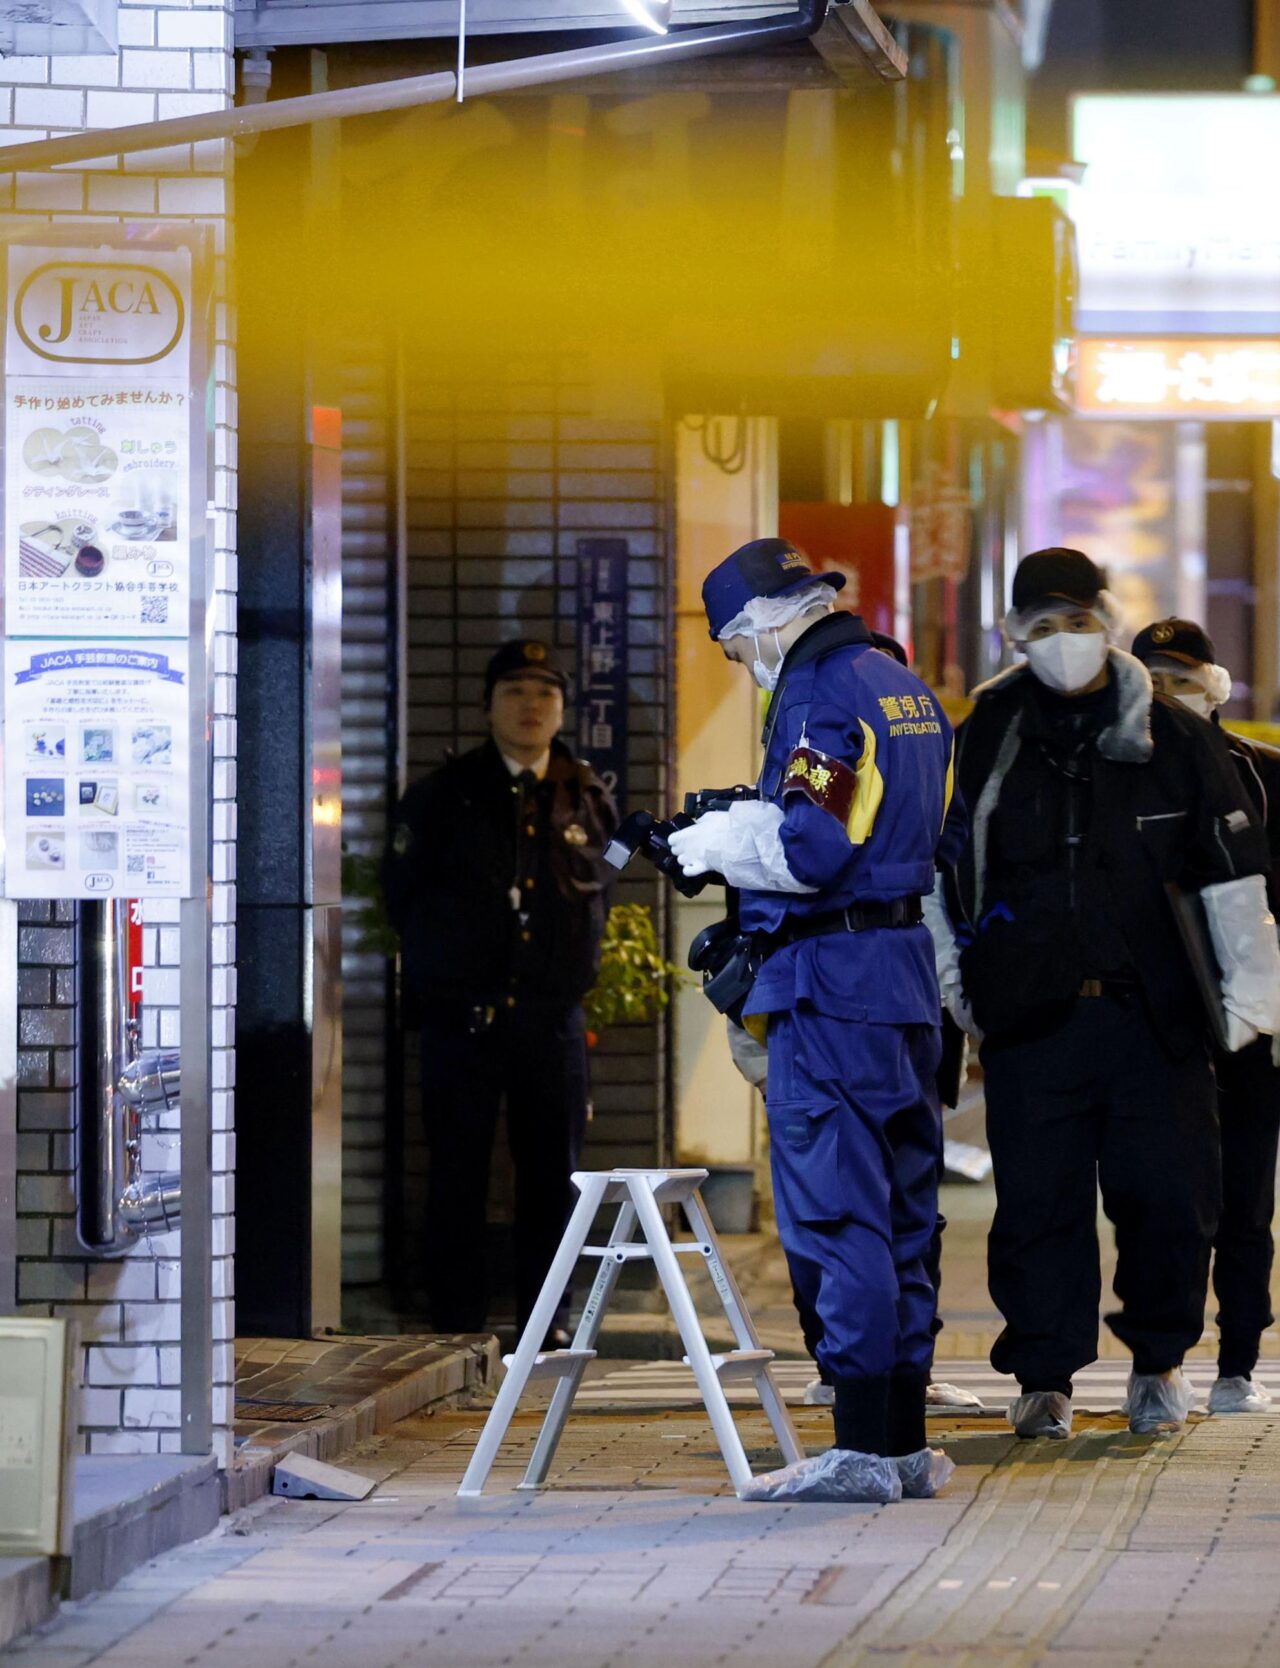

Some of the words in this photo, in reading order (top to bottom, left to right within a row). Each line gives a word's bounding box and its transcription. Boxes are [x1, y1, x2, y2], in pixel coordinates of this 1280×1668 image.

[38, 277, 161, 343] JACA
[14, 391, 185, 411] 手作り始めてみませんか？
[70, 416, 106, 435] tatting
[40, 655, 73, 669] JACA
[877, 695, 937, 721] 警視庁
